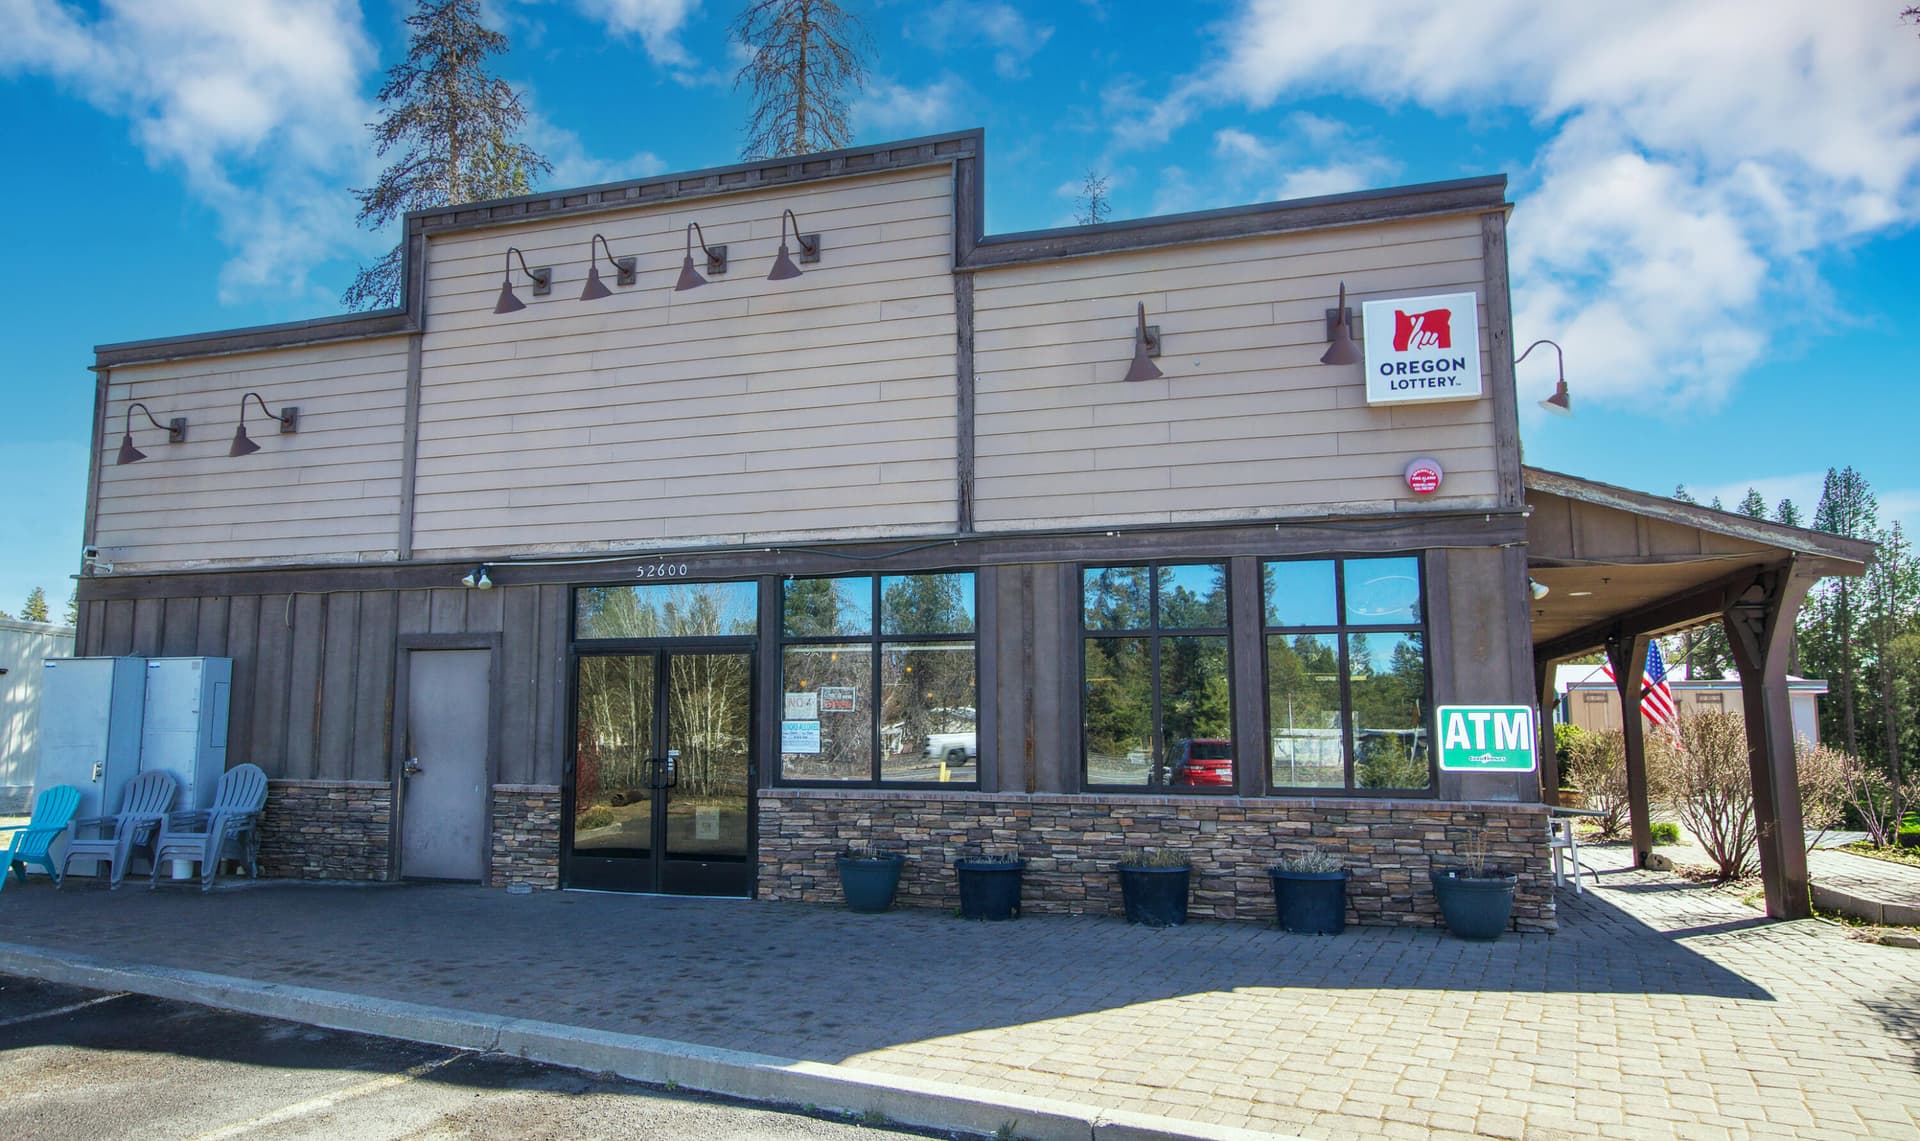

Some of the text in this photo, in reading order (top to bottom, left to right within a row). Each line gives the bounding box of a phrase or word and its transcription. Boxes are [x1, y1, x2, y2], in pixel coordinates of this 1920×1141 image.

[1380, 357, 1466, 376] OREGON
[1391, 376, 1457, 390] LOTTERY
[636, 563, 687, 578] 52600
[1445, 712, 1530, 750] ATM
